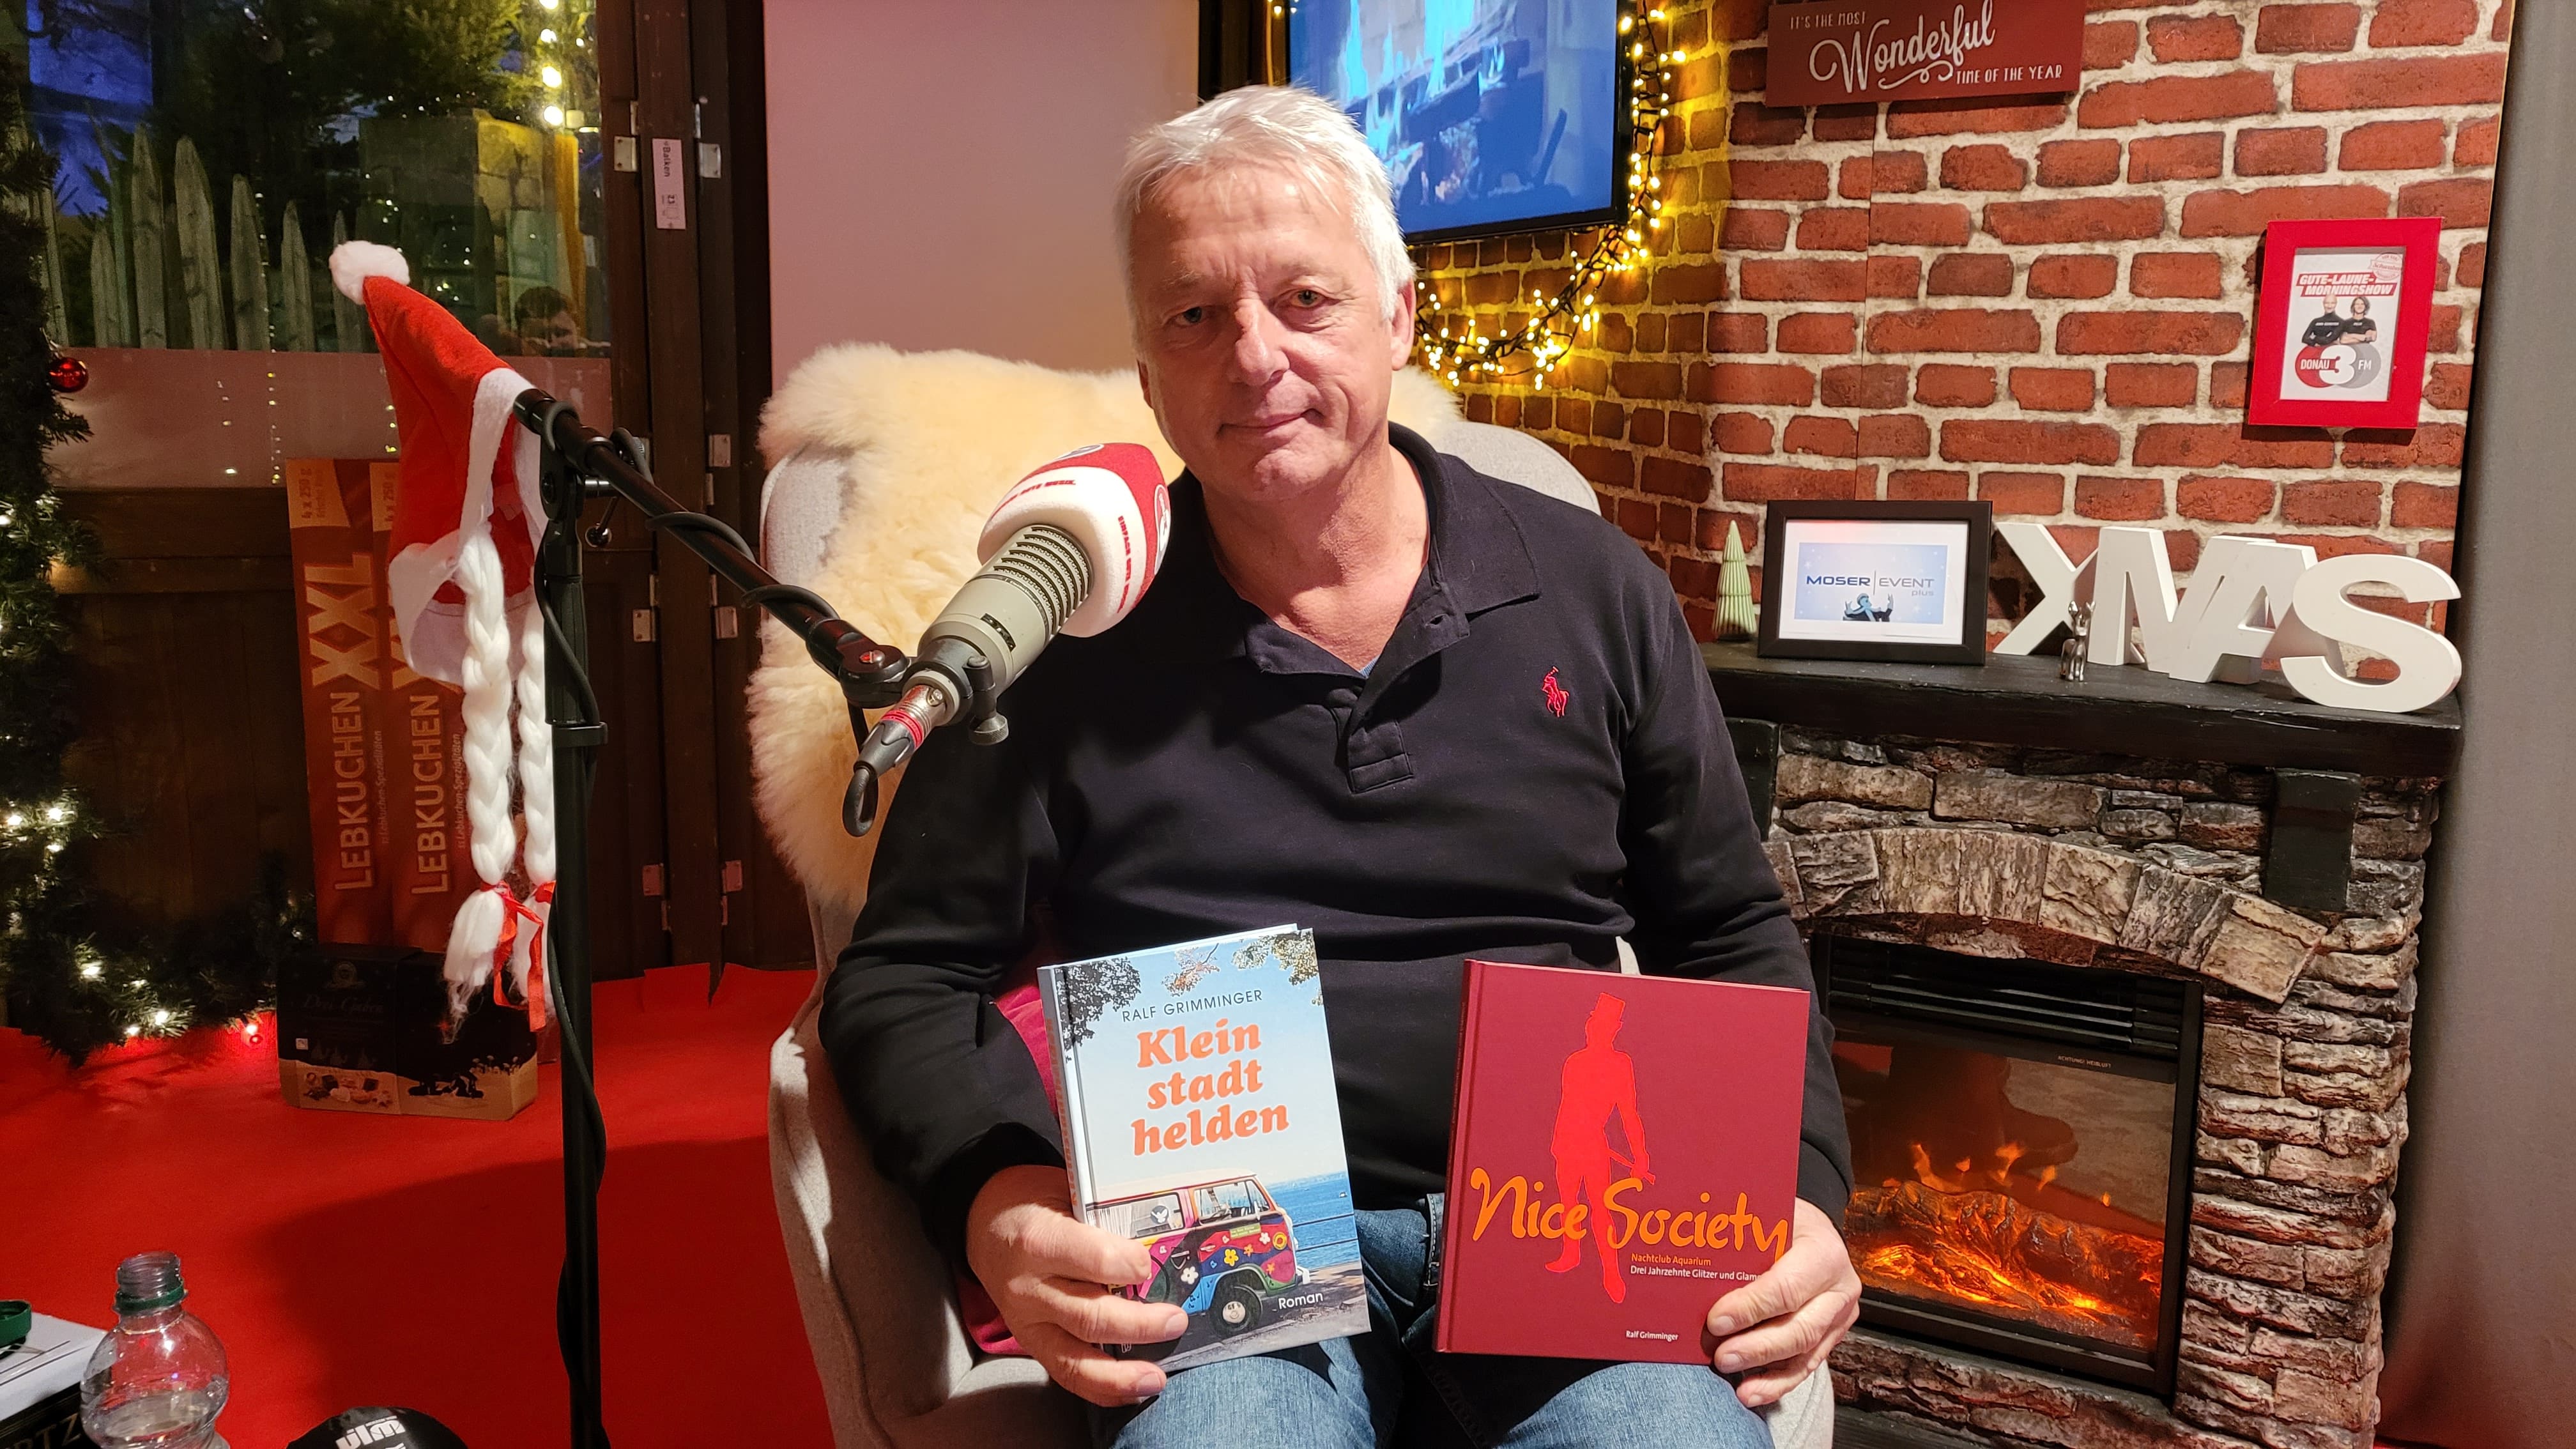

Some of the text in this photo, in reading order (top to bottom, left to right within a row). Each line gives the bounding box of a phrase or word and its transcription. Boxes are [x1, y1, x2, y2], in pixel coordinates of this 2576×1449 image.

[1815, 14, 1834, 27] THE
[1837, 11, 1867, 27] MOST
[1809, 0, 1997, 93] Wonderful
[1956, 64, 2063, 85] TIME OF THE YEAR
[662, 146, 671, 178] Balken
[2299, 273, 2374, 286] GUTE-LAUNE-
[2305, 284, 2392, 296] MORNINGSHOW
[2300, 344, 2372, 385] DONAU 3 FM
[298, 476, 312, 497] 250
[1806, 575, 1935, 589] MOSER EVENT
[1911, 588, 1935, 597] plus
[305, 554, 379, 689] XXL
[1993, 521, 2462, 712] XMAS
[330, 691, 372, 890] LEBKUCHEN
[409, 694, 448, 894] LEBKUCHEN
[1121, 988, 1263, 1023] RALF GRIMMINGER
[1136, 1018, 1262, 1069] Klein
[1146, 1059, 1264, 1111] stadt
[1130, 1103, 1290, 1157] helden
[1602, 1177, 1788, 1261] Society
[1630, 1252, 1712, 1268] Nachtclub Aquarium
[1630, 1264, 1646, 1275] Drei
[1646, 1265, 1691, 1279] Jahrzehnte
[1692, 1269, 1719, 1279] Glitzer
[1719, 1271, 1735, 1280] und
[1278, 1290, 1324, 1311] Roman
[1625, 1330, 1679, 1342] Ralf Grimminger
